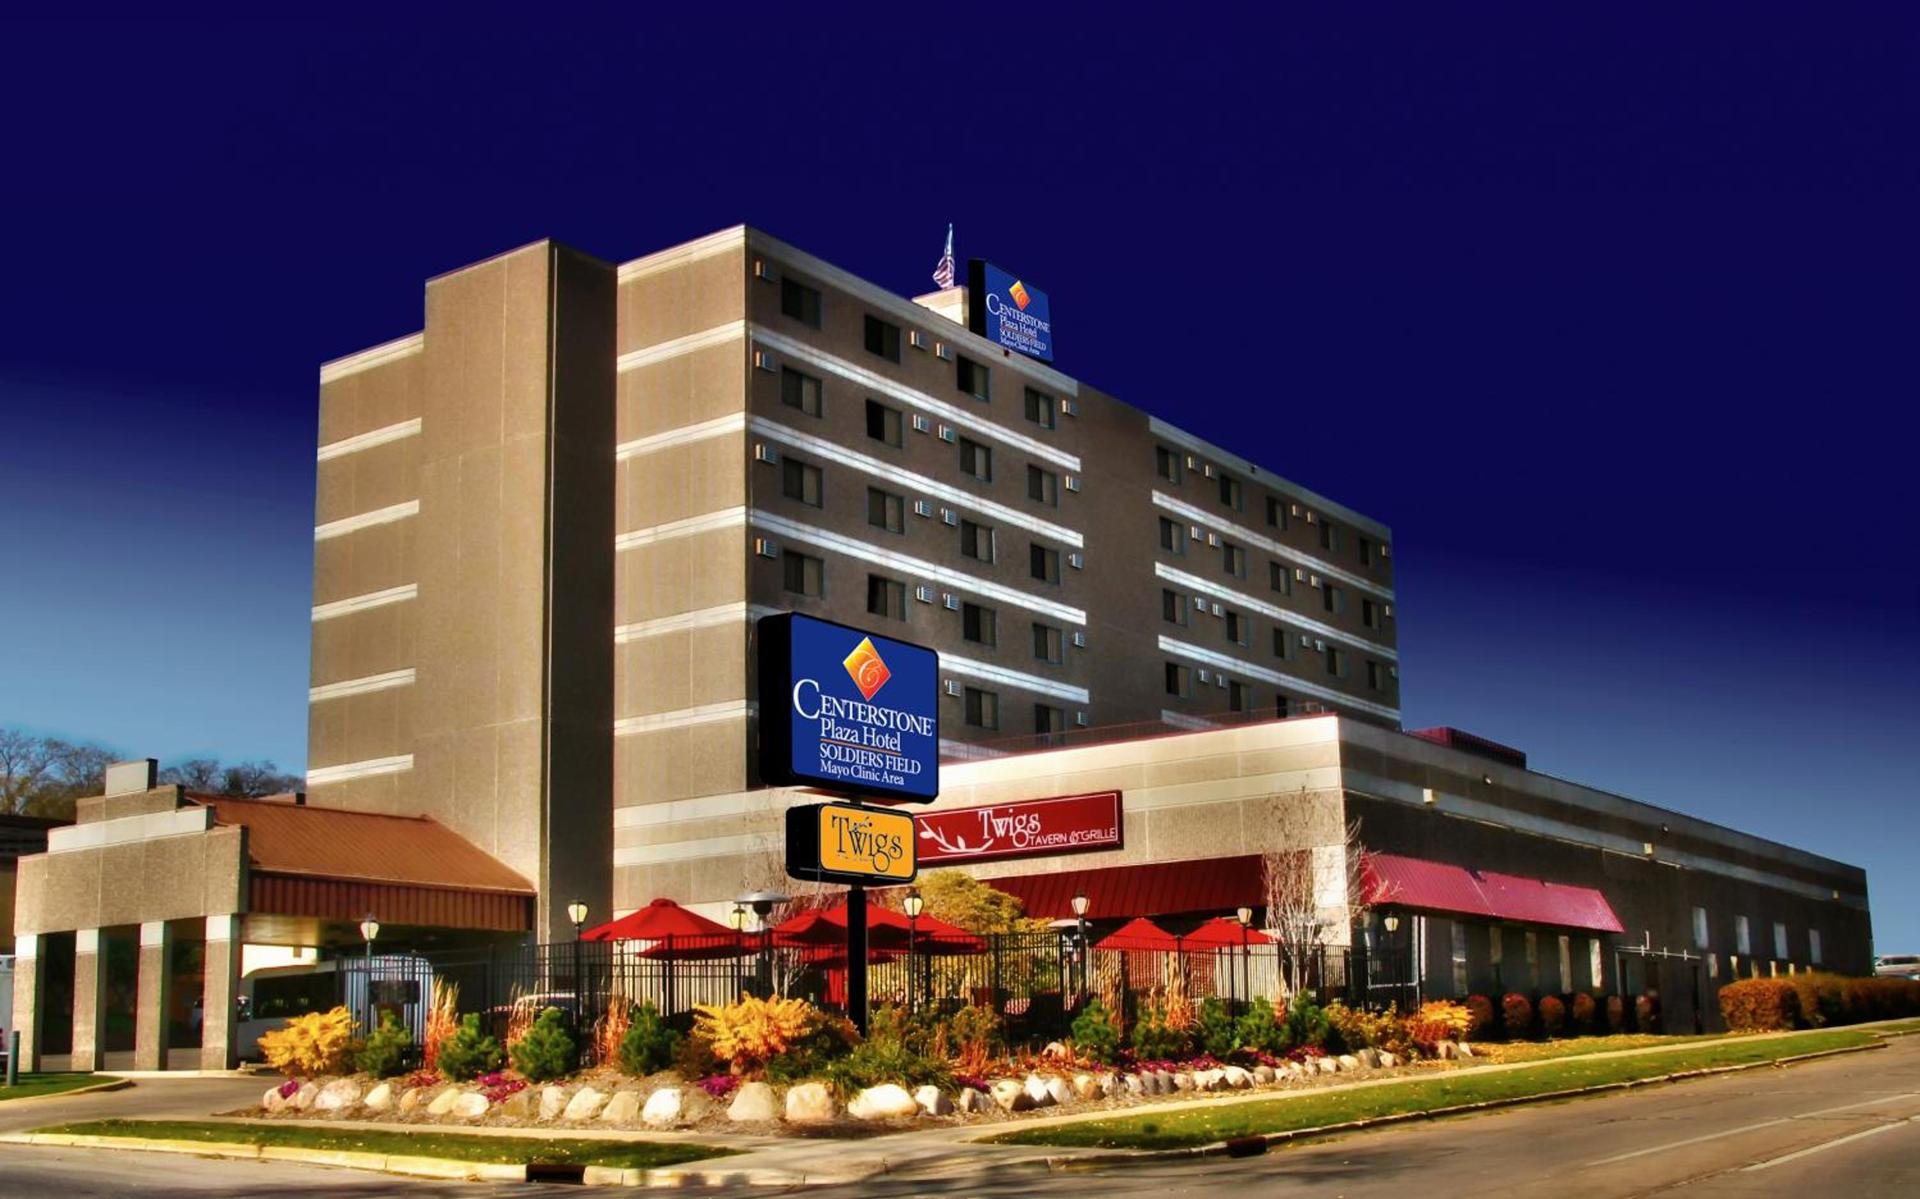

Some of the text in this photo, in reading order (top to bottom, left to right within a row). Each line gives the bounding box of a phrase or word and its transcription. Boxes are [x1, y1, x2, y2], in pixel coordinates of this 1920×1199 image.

[986, 293, 1050, 333] CENTERSTONE
[793, 679, 933, 736] CENTERSTONE
[820, 717, 901, 751] Plaza Hotel
[820, 743, 921, 775] SOLDIERS FIELD
[820, 759, 904, 785] Mayo Clinic Area
[832, 815, 903, 873] Twigs
[978, 808, 1041, 848] Twigs
[1028, 833, 1067, 846] TAVERN
[1083, 827, 1116, 842] GRILLE
